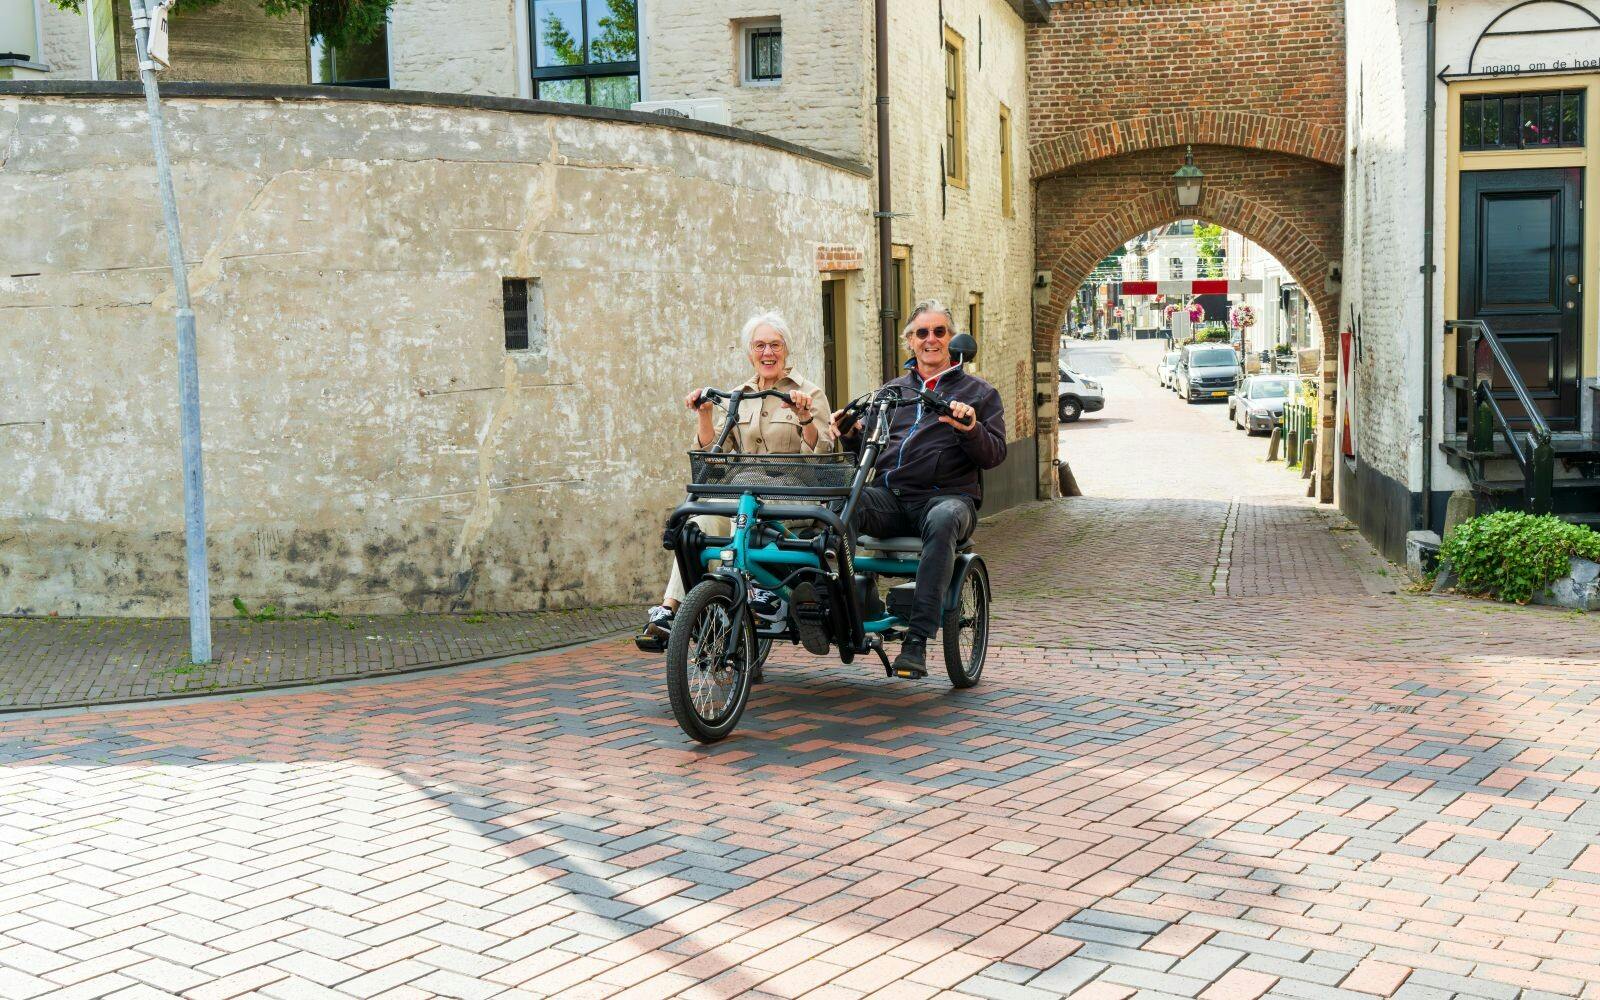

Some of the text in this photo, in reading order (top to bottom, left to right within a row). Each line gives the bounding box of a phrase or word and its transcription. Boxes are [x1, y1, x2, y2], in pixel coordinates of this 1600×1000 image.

[1482, 57, 1600, 77] ingang om de hoe
